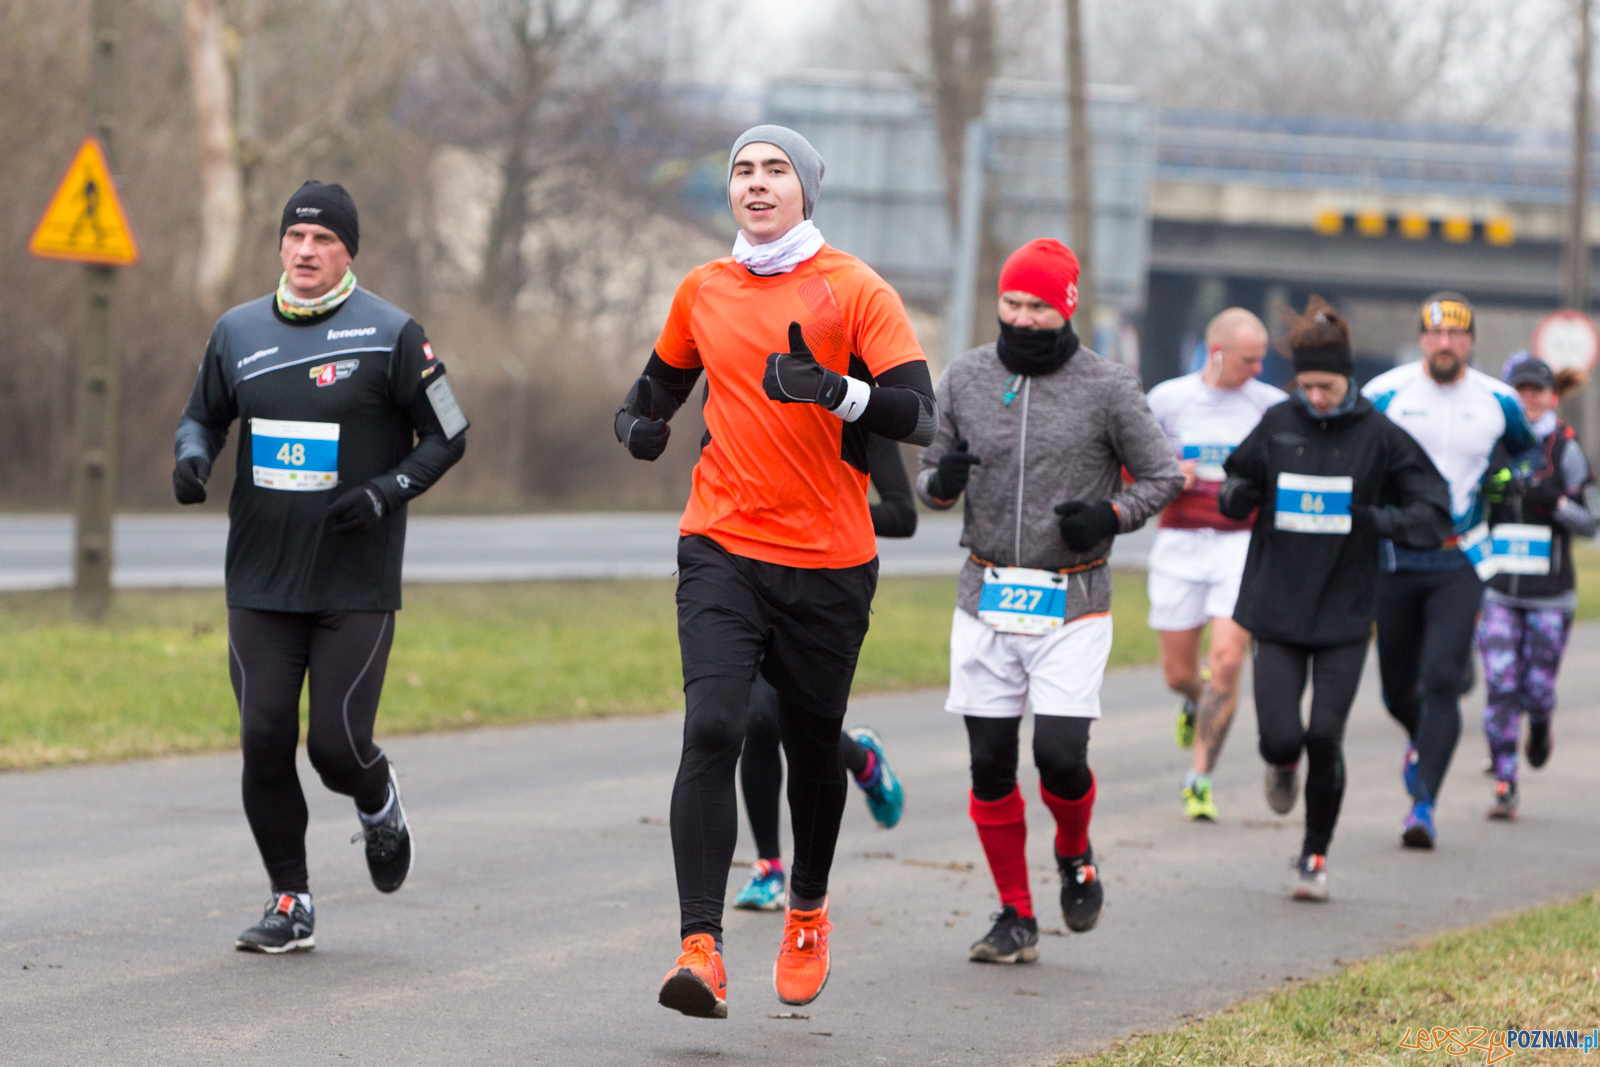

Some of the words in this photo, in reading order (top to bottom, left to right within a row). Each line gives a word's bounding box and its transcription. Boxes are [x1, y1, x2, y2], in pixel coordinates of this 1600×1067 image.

[327, 327, 377, 341] lenovo
[276, 442, 306, 466] 48
[1300, 492, 1325, 513] 86
[998, 587, 1043, 612] 227
